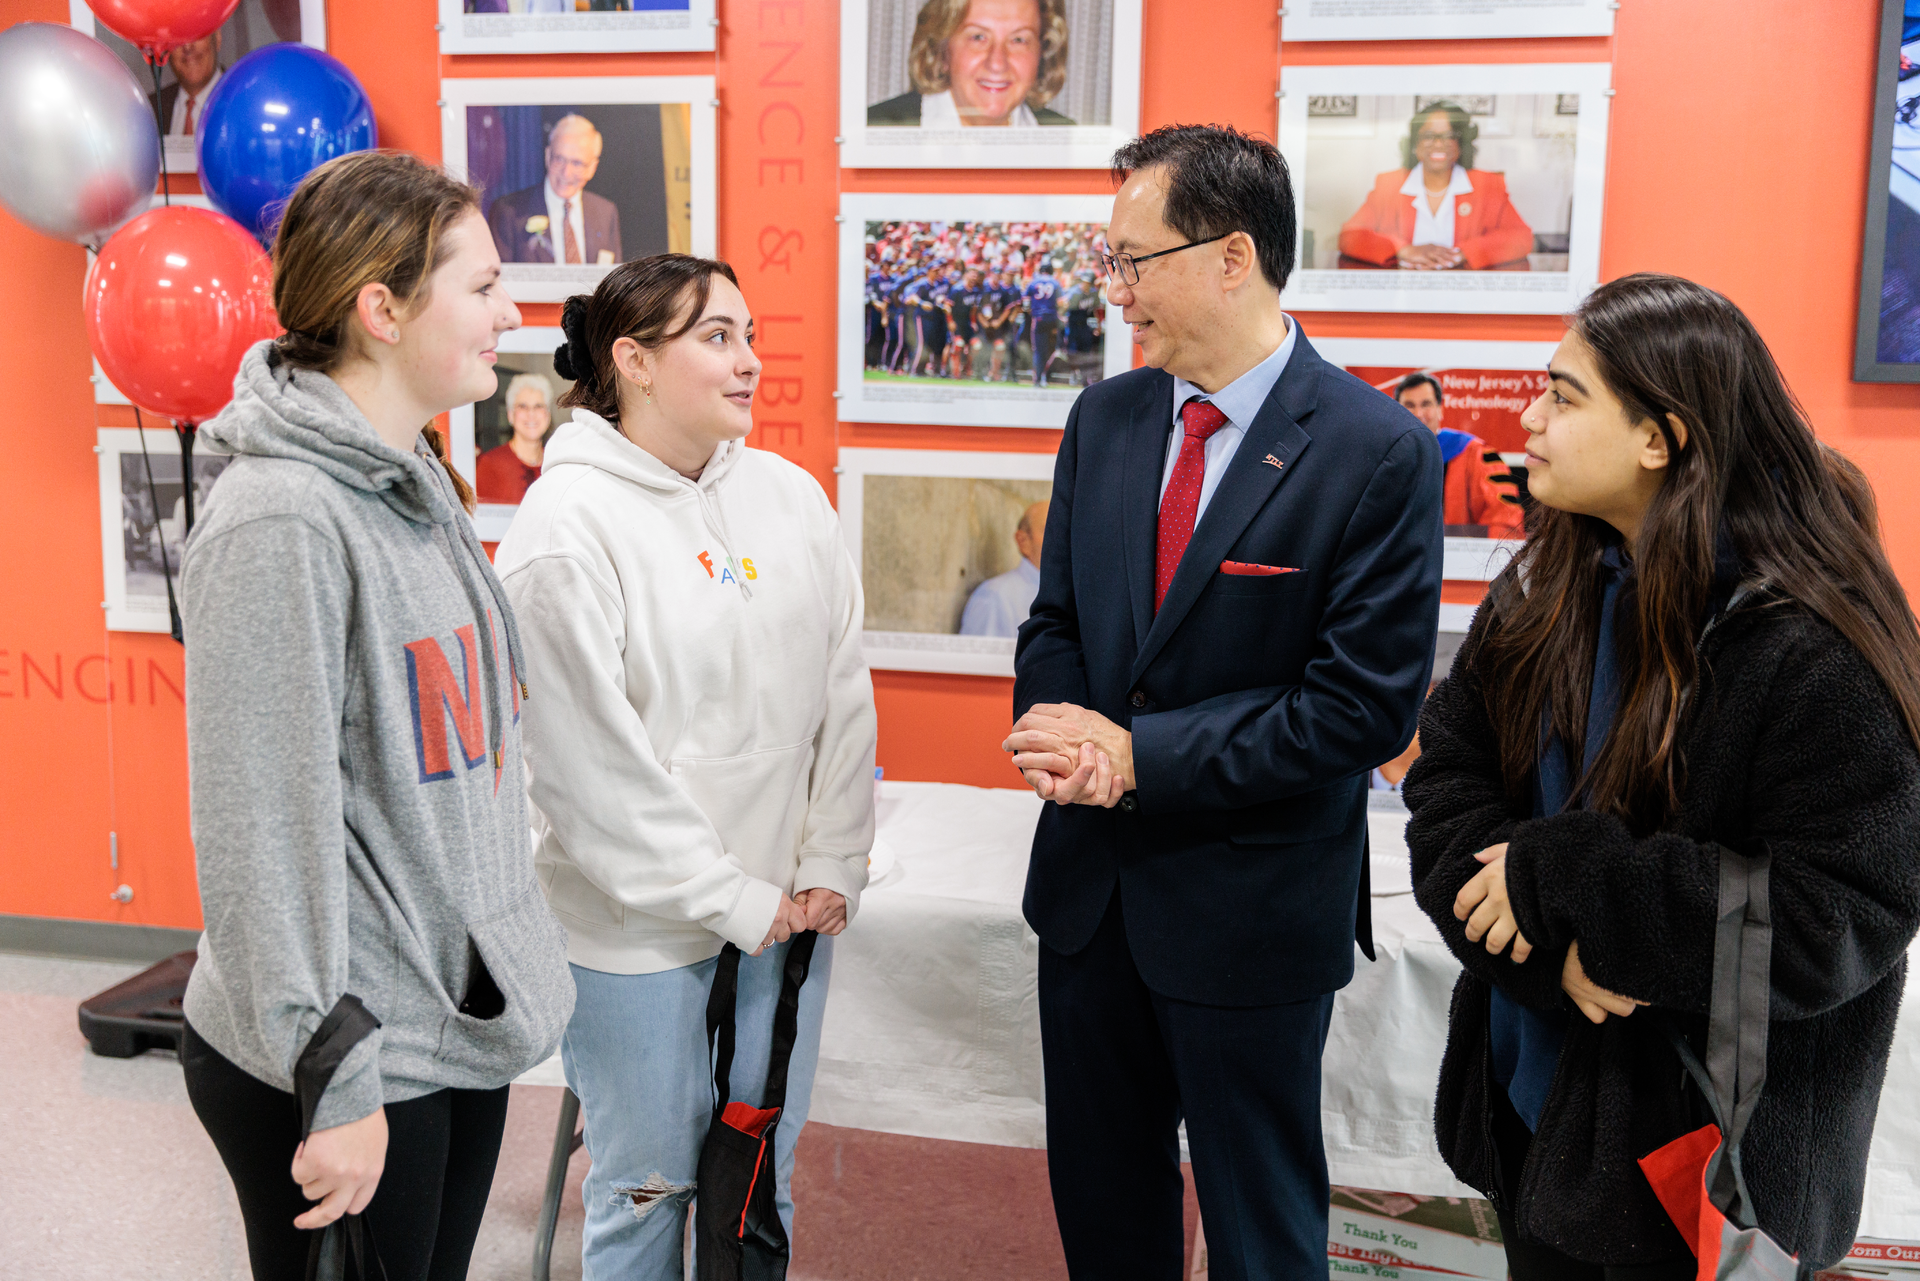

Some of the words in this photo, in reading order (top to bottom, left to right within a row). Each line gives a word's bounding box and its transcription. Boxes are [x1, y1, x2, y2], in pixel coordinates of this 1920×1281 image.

[1034, 281, 1055, 301] 39
[758, 313, 804, 463] LIBE
[1443, 374, 1478, 390] New
[1444, 394, 1527, 413] Technology
[1343, 1221, 1388, 1243] Thank
[1391, 1232, 1418, 1250] You
[1372, 1264, 1400, 1280] You
